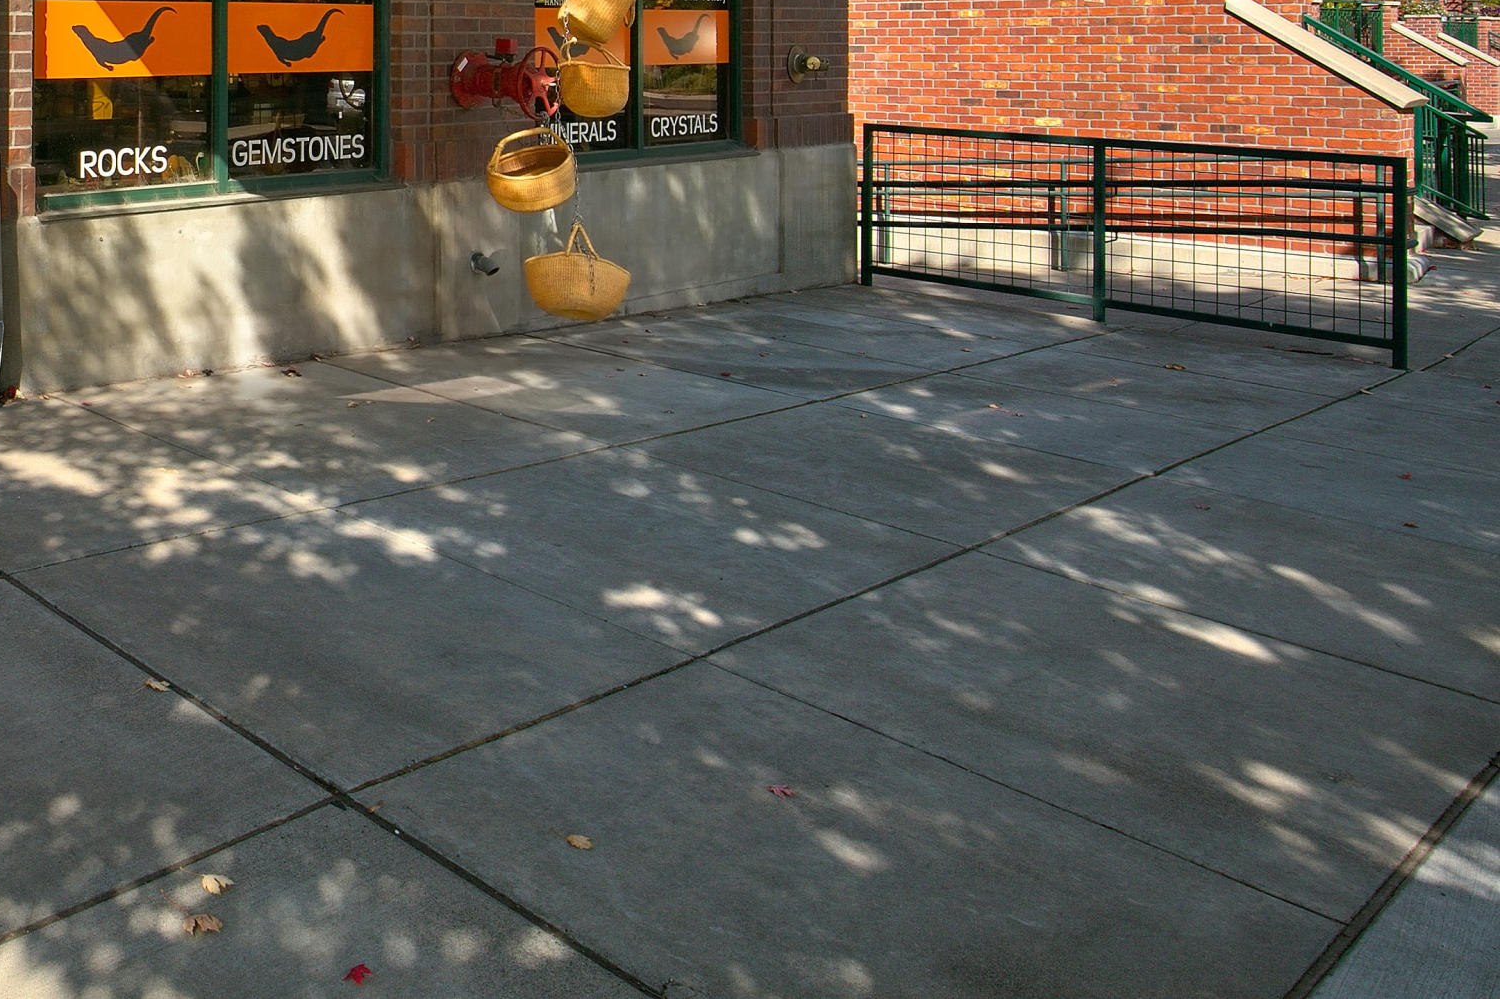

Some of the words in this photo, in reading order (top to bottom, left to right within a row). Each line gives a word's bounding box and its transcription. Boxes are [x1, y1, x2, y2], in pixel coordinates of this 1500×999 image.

[651, 113, 718, 138] CRYSTALS
[79, 145, 168, 179] ROCKS
[232, 133, 365, 167] GEMSTONES
